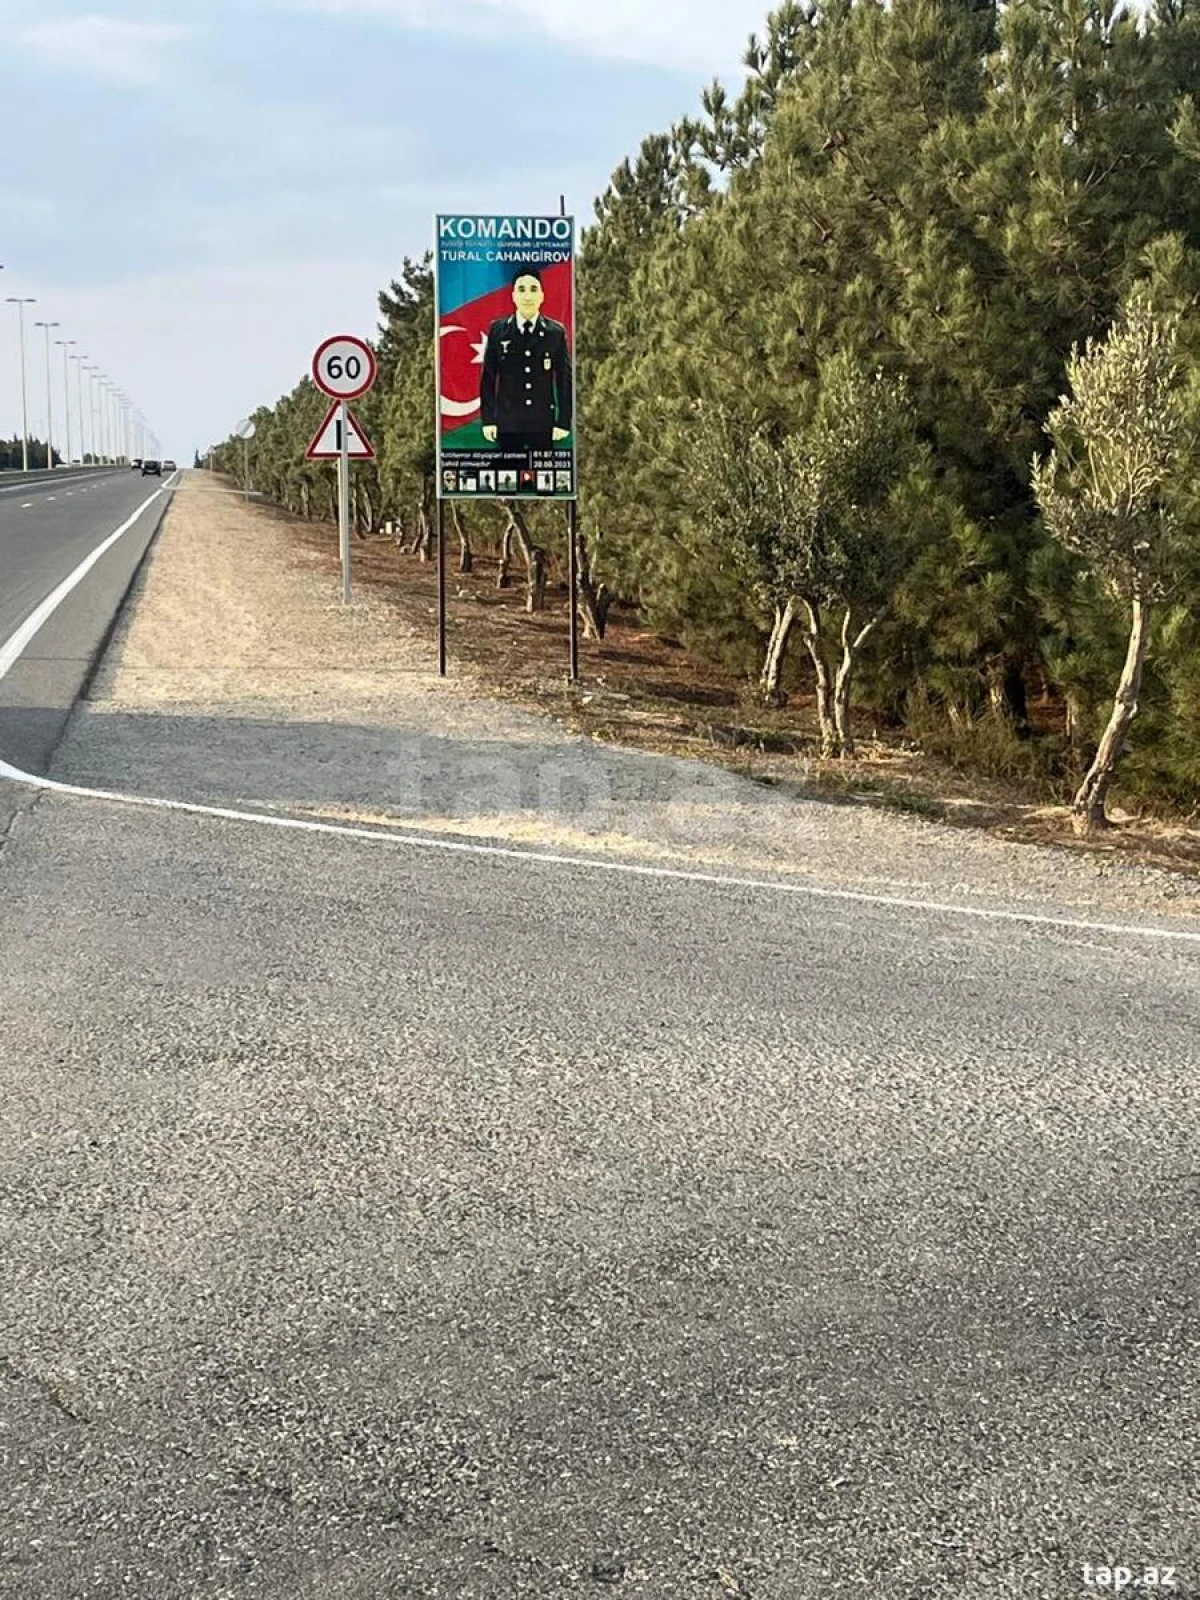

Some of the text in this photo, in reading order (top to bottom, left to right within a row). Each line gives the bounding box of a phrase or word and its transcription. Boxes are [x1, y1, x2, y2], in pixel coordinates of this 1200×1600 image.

[439, 218, 571, 240] KOMANDO
[441, 248, 570, 262] TURAL CAHANGİROV
[327, 355, 361, 380] 60
